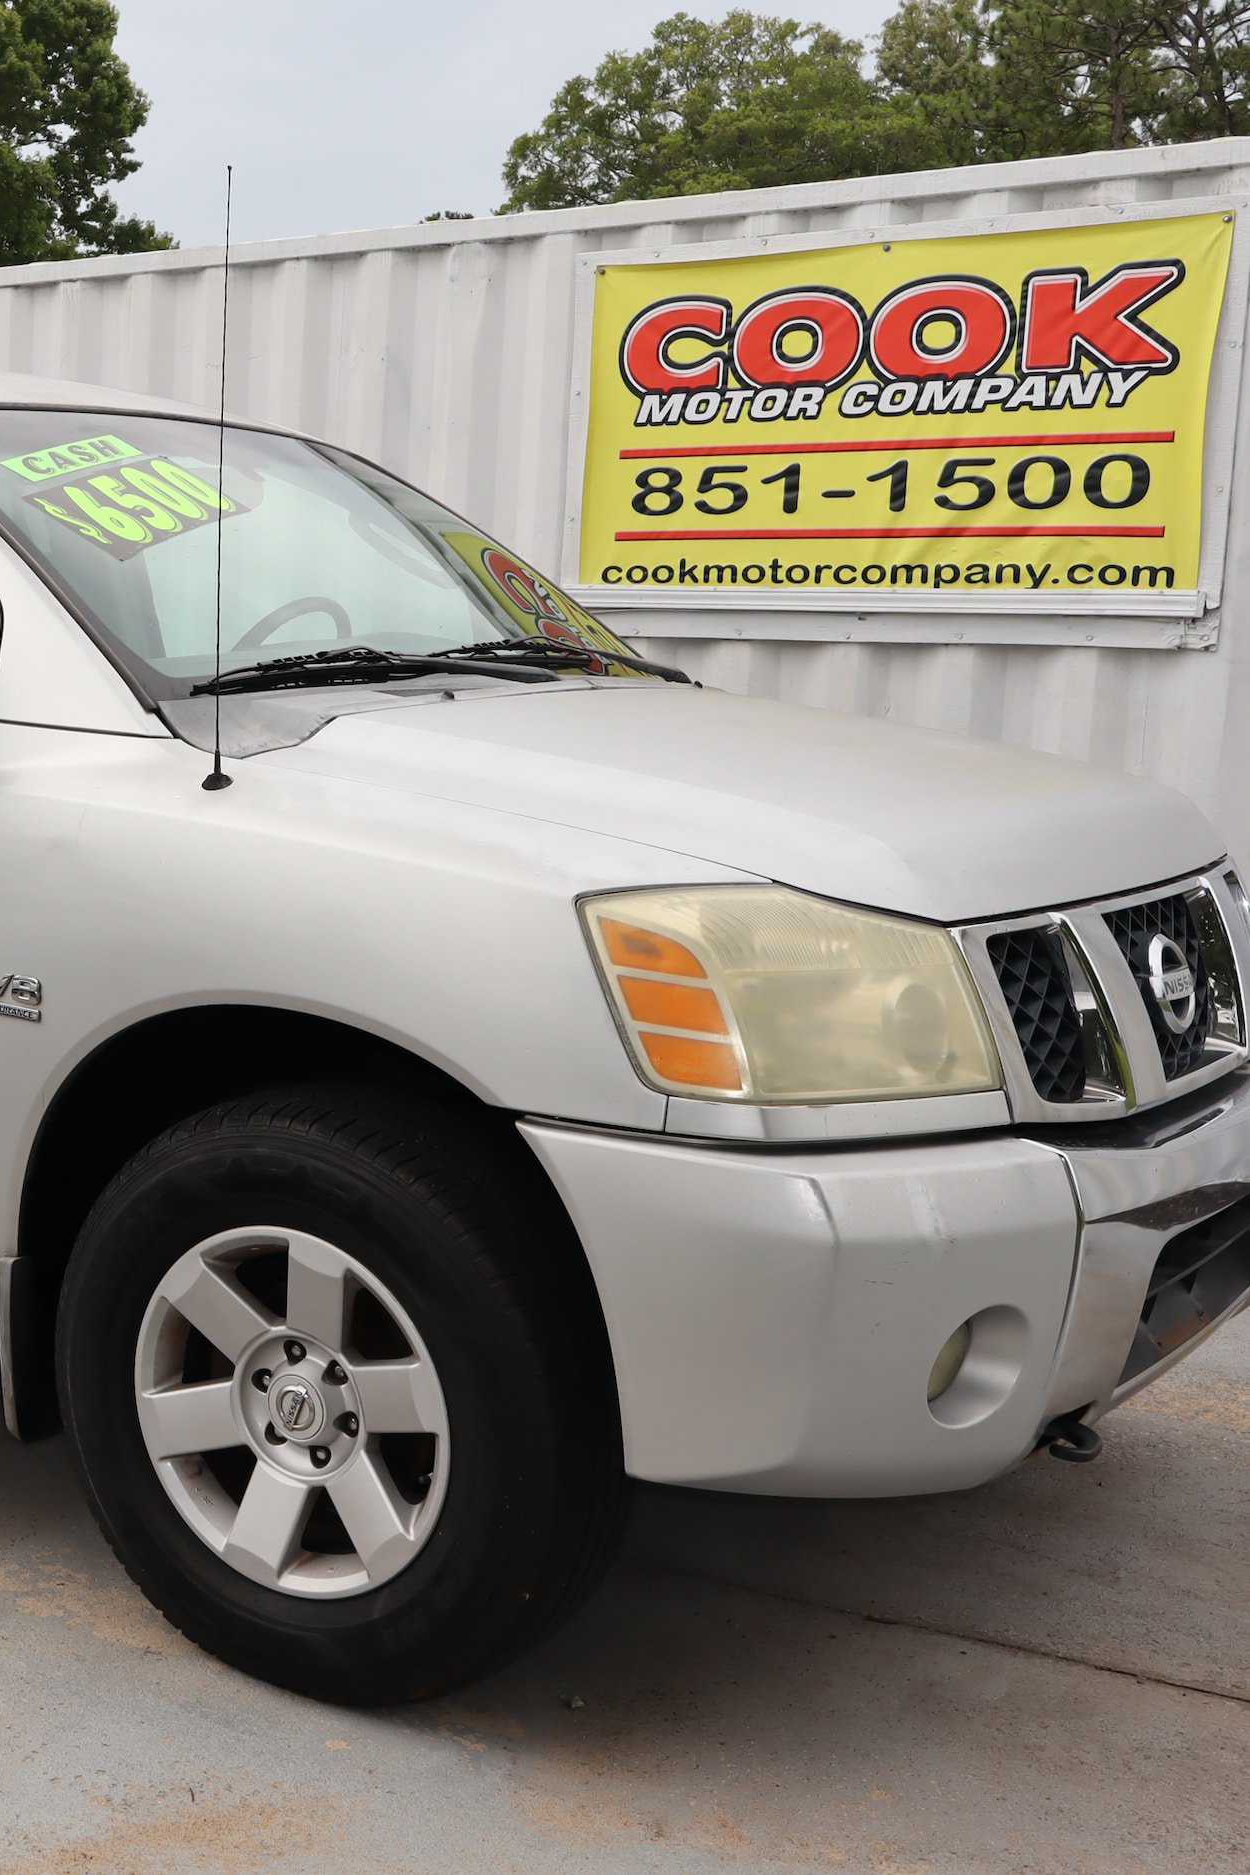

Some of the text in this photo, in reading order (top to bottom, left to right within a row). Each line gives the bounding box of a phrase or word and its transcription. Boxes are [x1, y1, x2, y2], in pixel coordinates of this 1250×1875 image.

[619, 257, 1186, 394] COOK
[634, 369, 1150, 426] MOTOR COMPANY
[21, 439, 125, 477] CASH
[631, 453, 1151, 516] 851-1500
[33, 459, 237, 545] $6500
[601, 557, 1176, 589] cookmotorcompany.com
[285, 1390, 304, 1427] NISSAN
